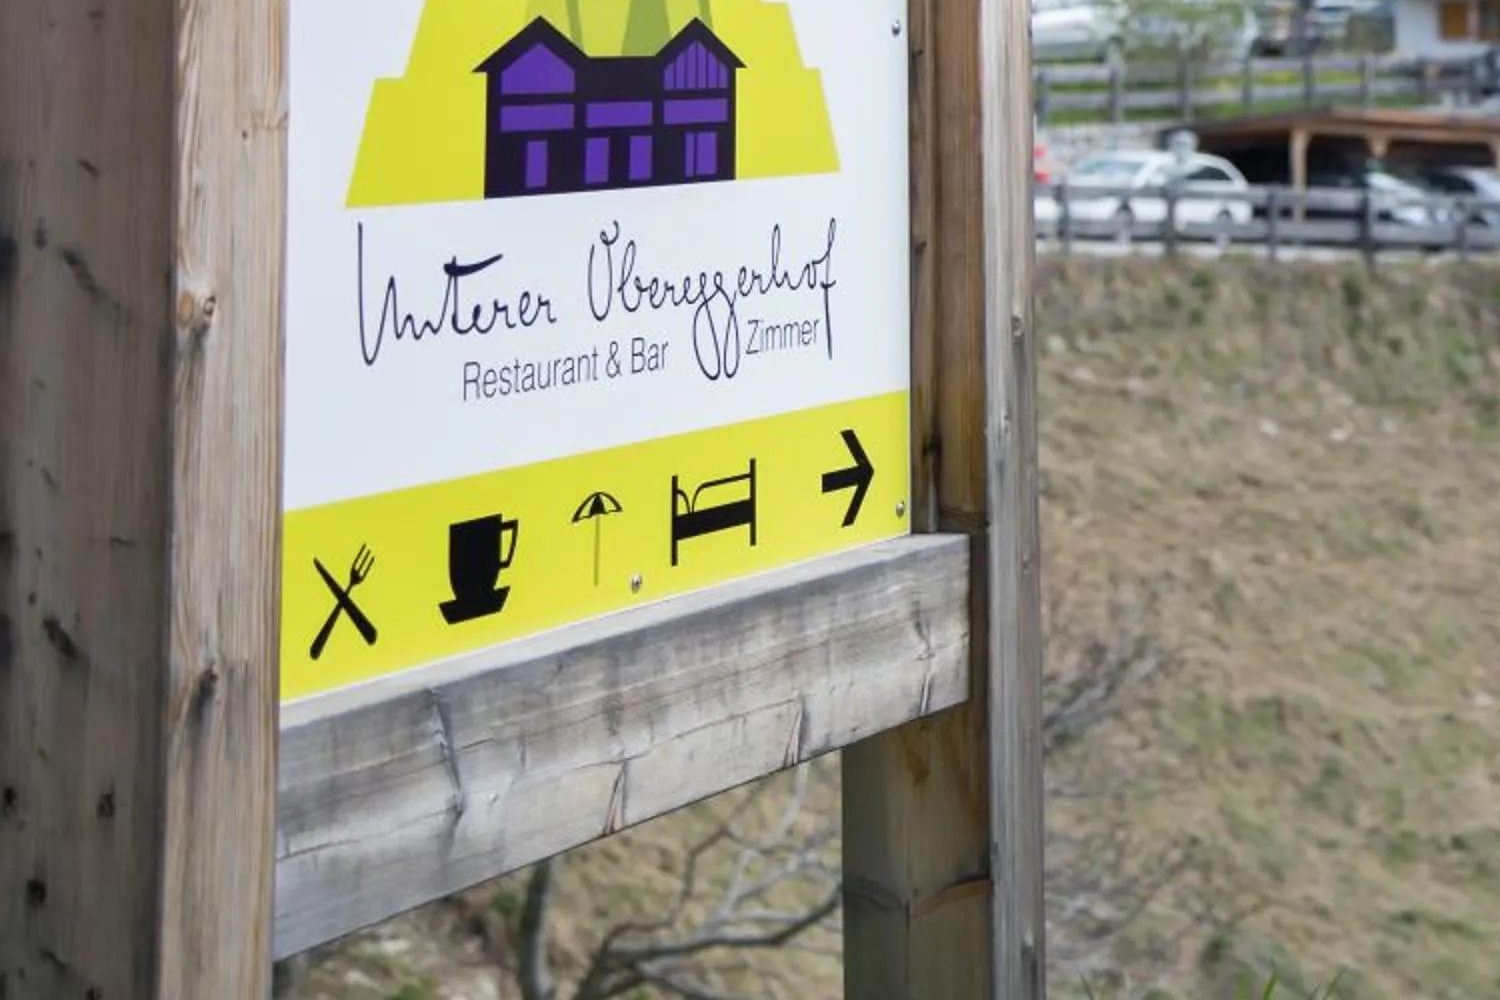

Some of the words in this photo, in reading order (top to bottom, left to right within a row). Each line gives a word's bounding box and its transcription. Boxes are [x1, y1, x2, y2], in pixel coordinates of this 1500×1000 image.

[357, 221, 558, 366] Unterer
[462, 346, 600, 401] Restaurant
[605, 340, 623, 380] &
[630, 336, 670, 375] Bar
[745, 318, 820, 356] Zimmer
